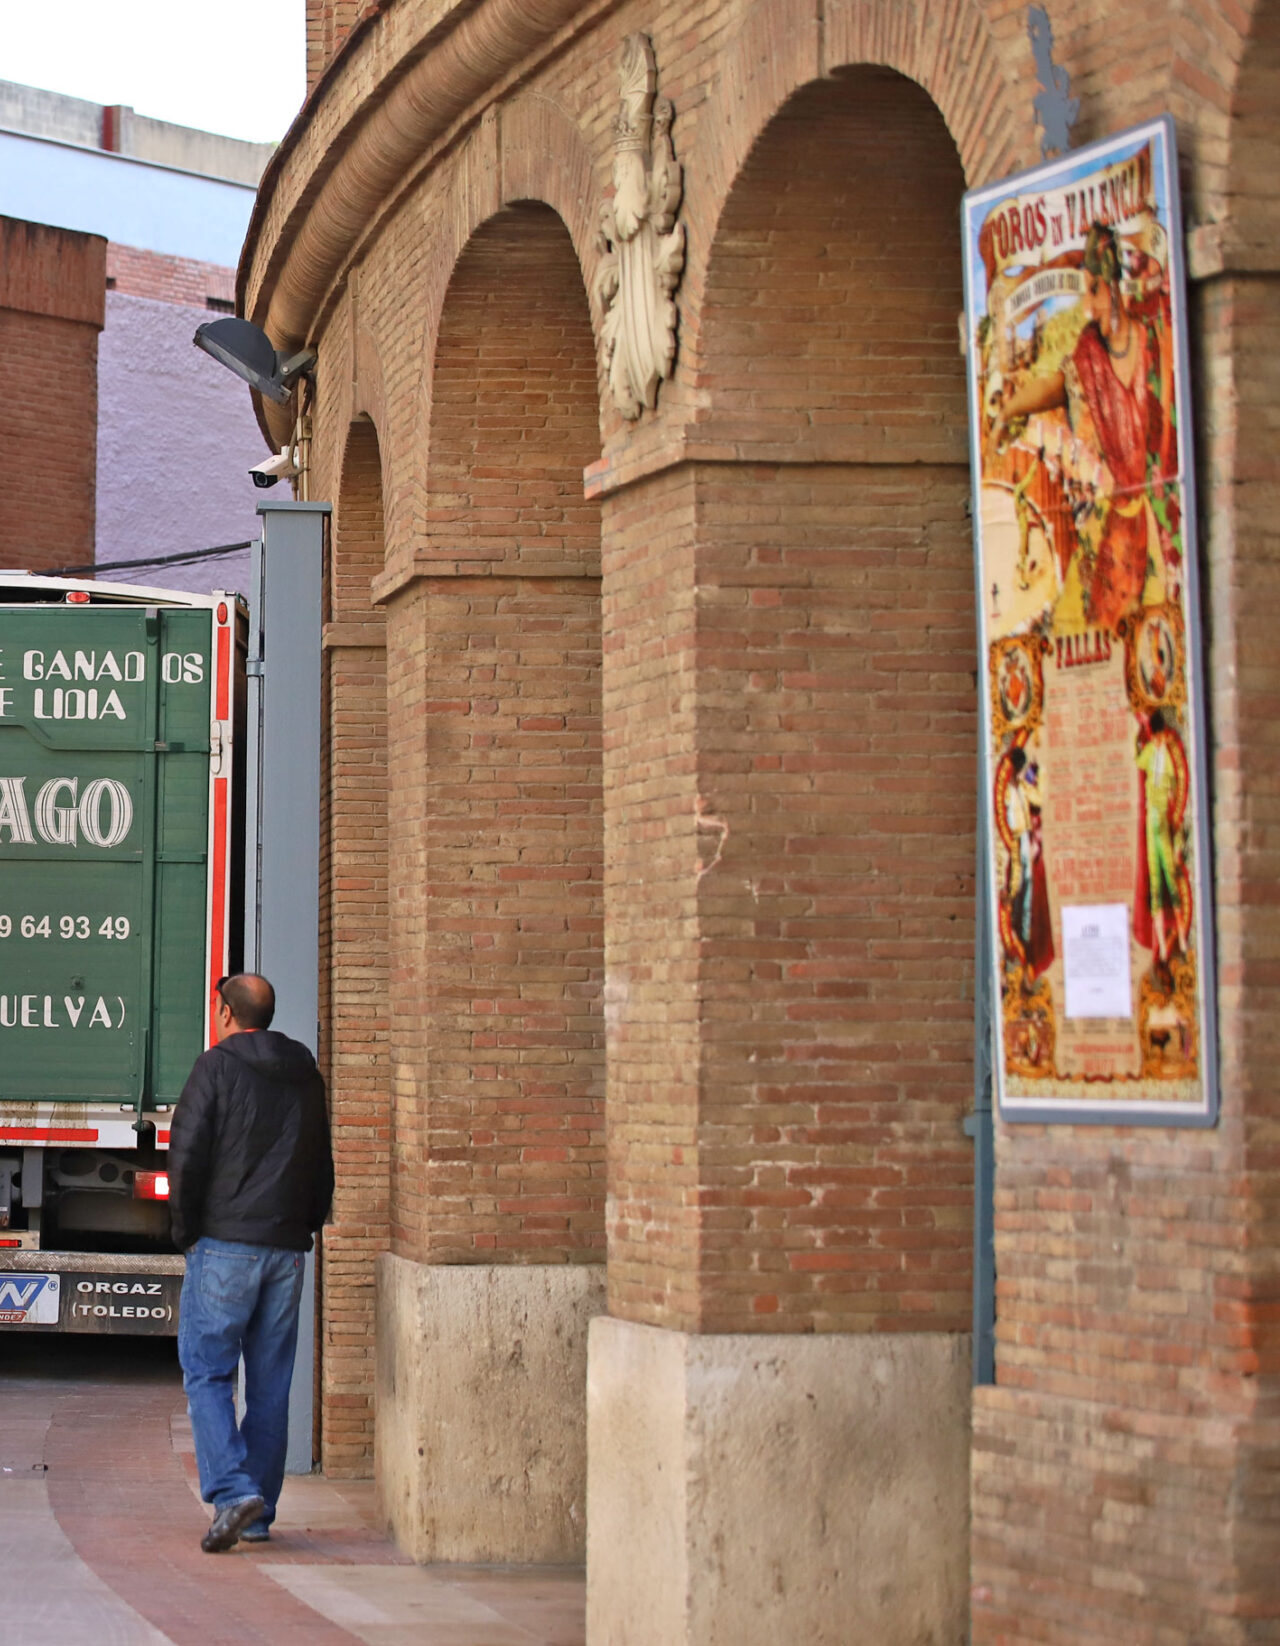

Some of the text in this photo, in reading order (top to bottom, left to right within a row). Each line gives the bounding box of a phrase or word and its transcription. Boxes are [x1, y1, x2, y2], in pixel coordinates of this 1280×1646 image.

[34, 688, 127, 720] LIDIA
[20, 916, 52, 938] 64
[59, 916, 91, 939] 93
[98, 916, 131, 940] 49
[76, 1281, 162, 1295] ORGAZ
[72, 1302, 172, 1321] (TOLEDO)
